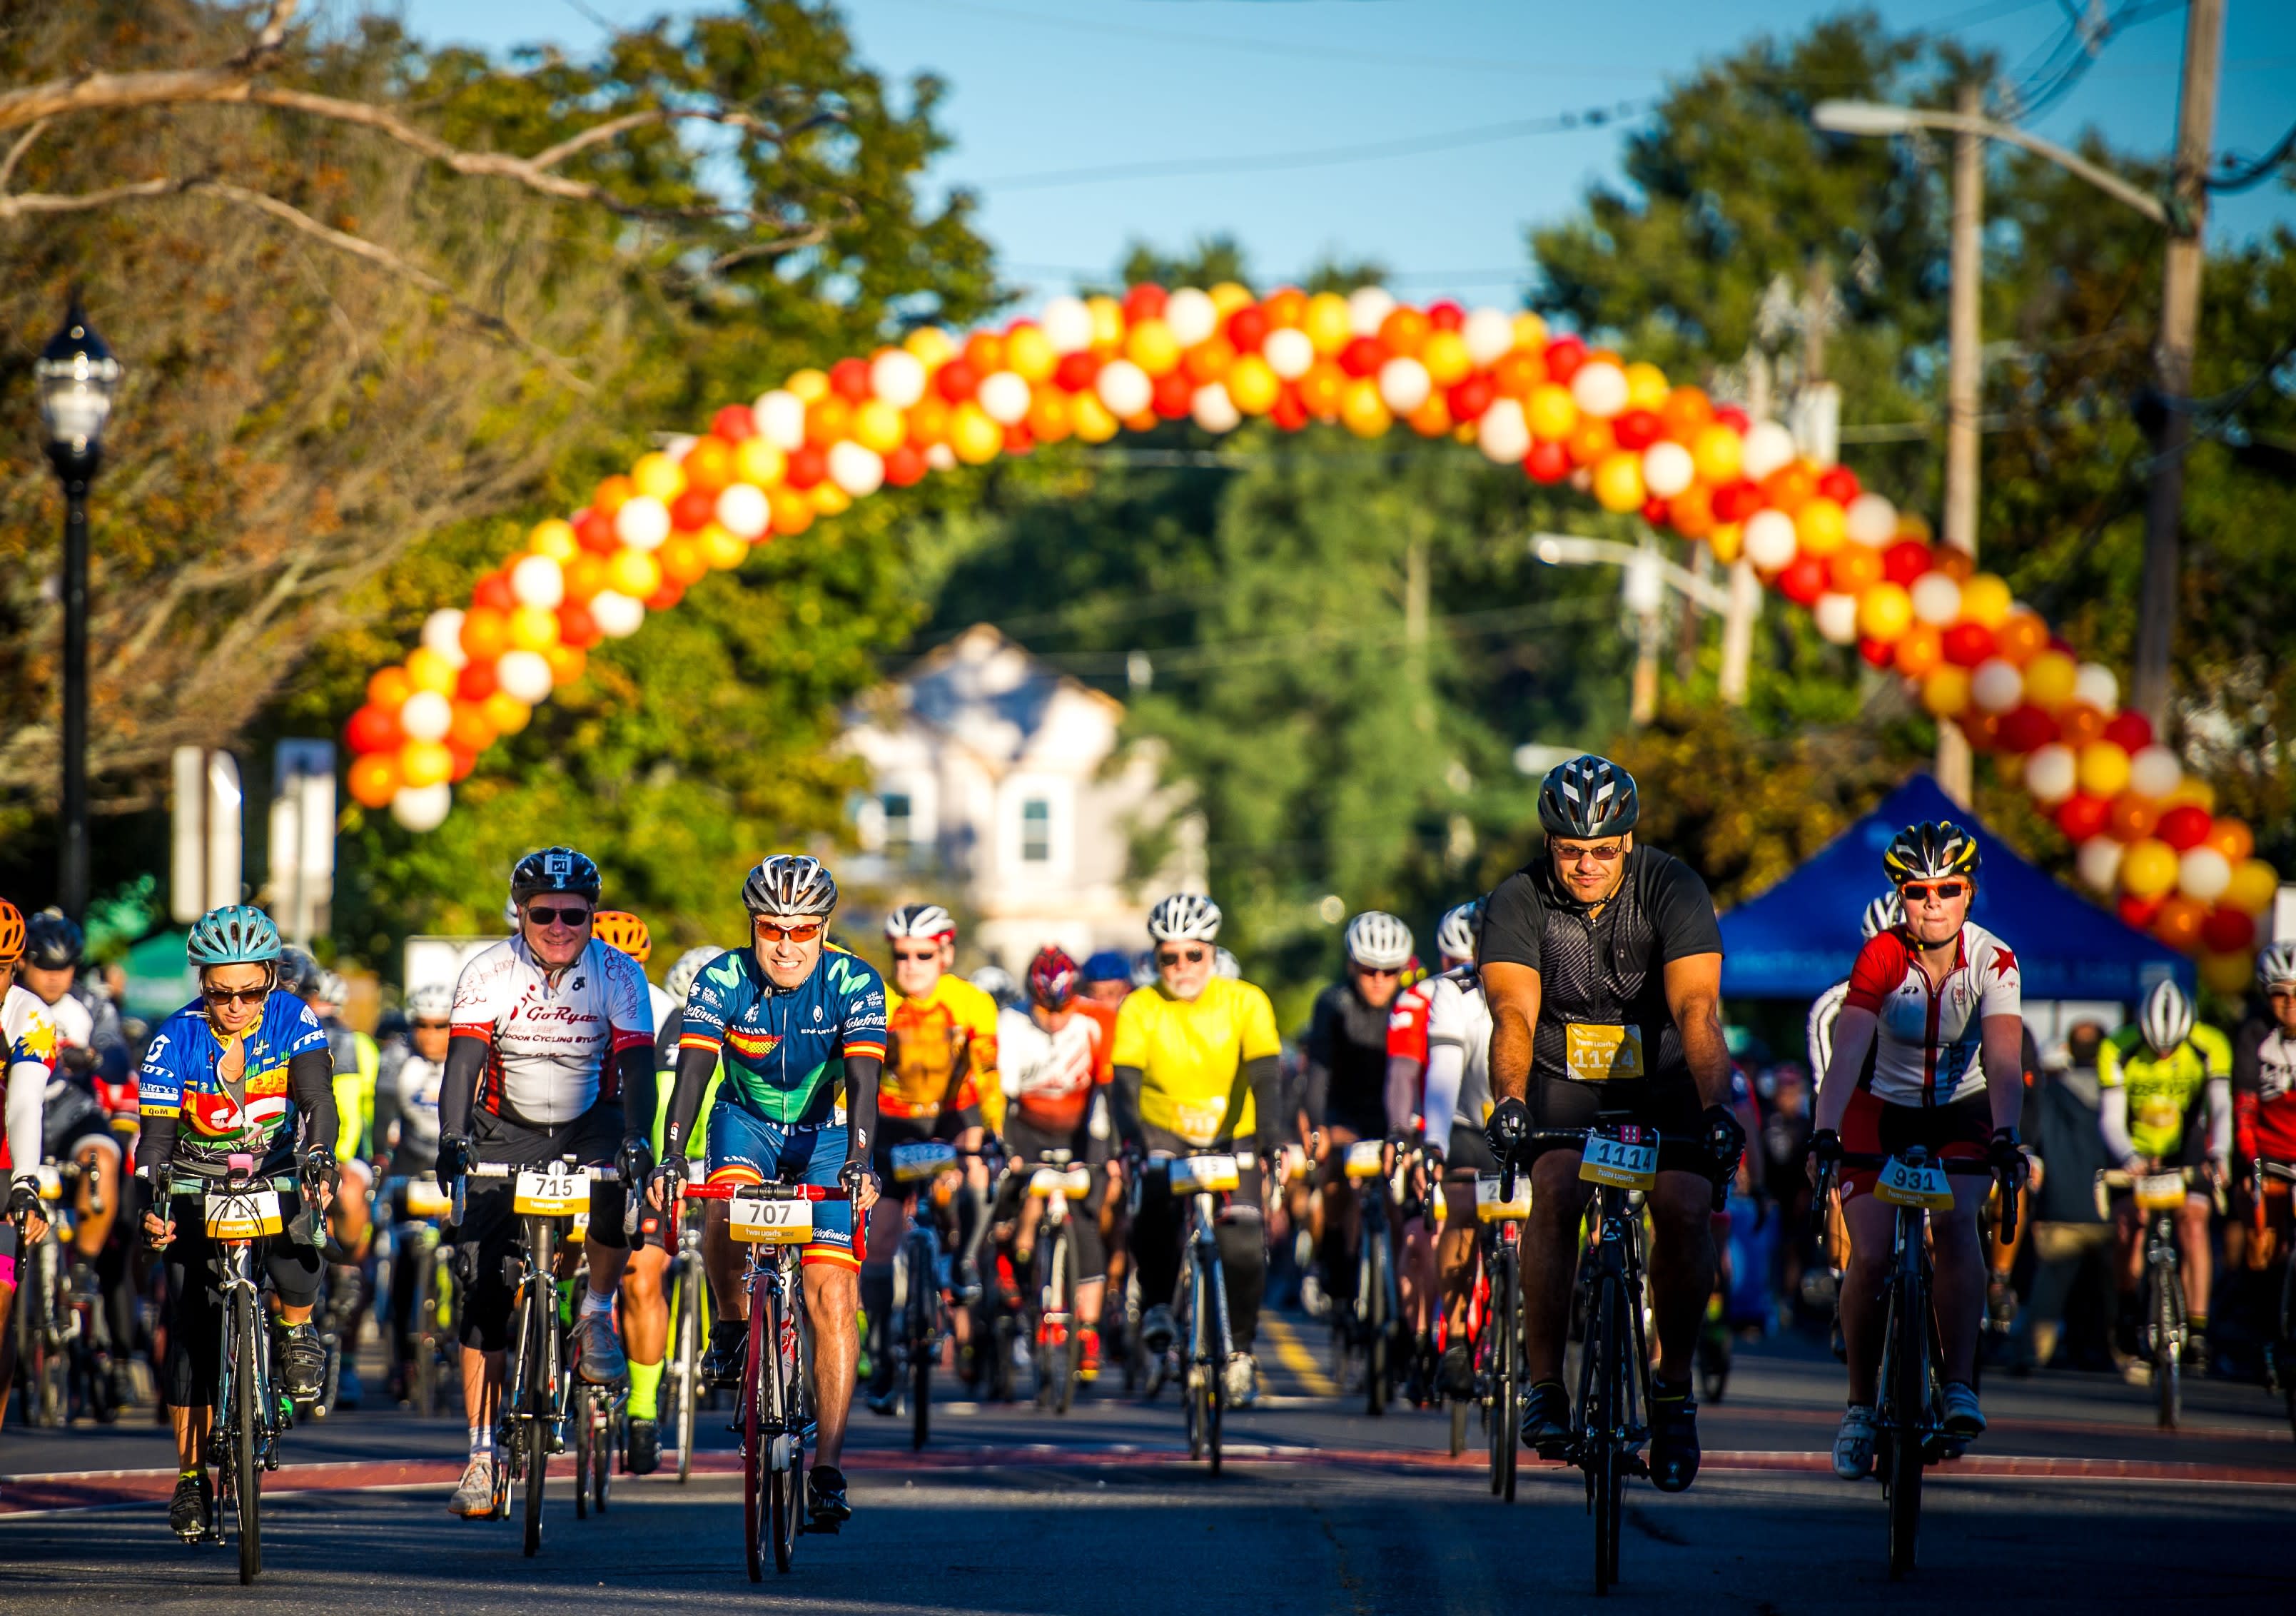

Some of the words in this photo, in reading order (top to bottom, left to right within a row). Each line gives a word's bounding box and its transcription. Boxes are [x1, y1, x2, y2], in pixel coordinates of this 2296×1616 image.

[293, 1029, 326, 1051] TRE
[1574, 1049, 1634, 1068] 1114
[1597, 1143, 1652, 1170] 1114
[537, 1178, 572, 1196] 715
[1893, 1168, 1936, 1191] 931
[221, 1197, 261, 1219] 714
[749, 1203, 792, 1224] 707
